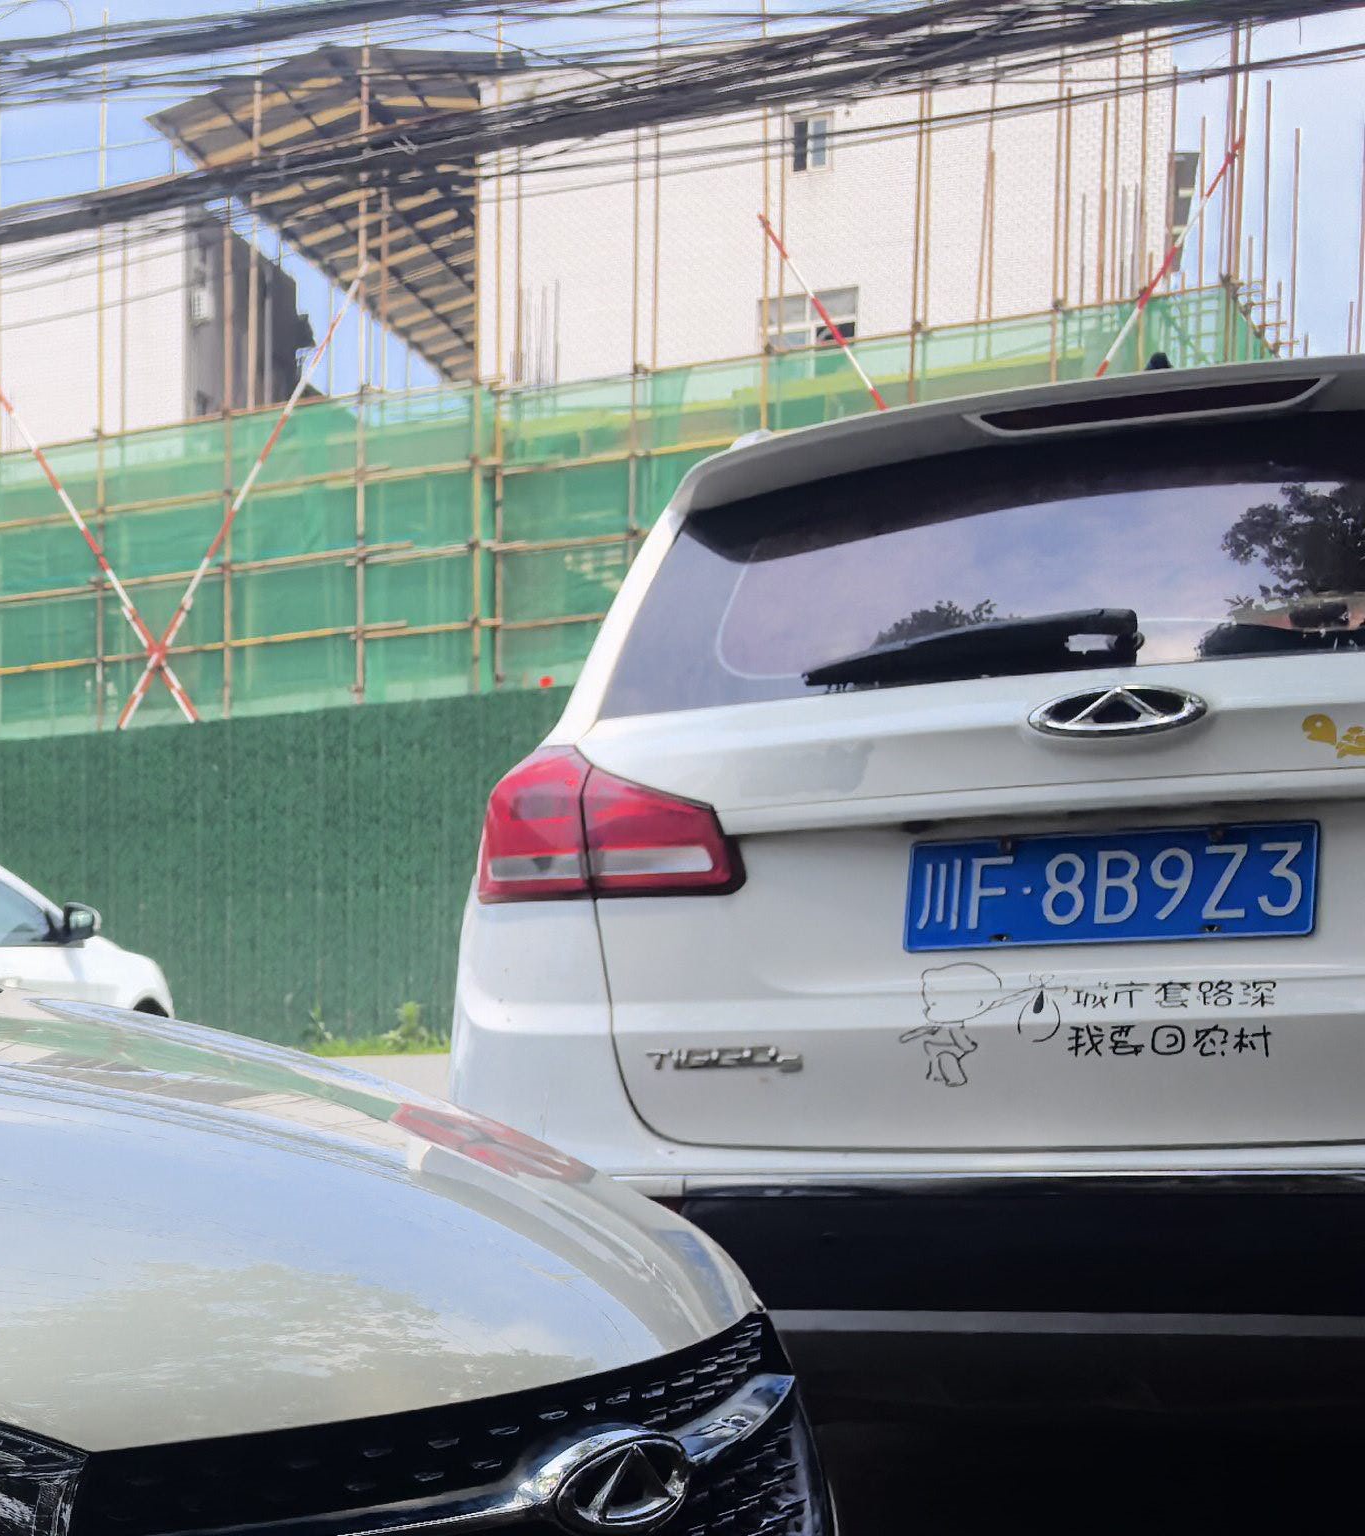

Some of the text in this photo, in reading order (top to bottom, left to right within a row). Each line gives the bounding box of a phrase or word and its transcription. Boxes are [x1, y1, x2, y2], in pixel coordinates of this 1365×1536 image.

[915, 840, 1305, 931] 川F·8B9Z3
[1066, 1022, 1274, 1058] 我要回农村
